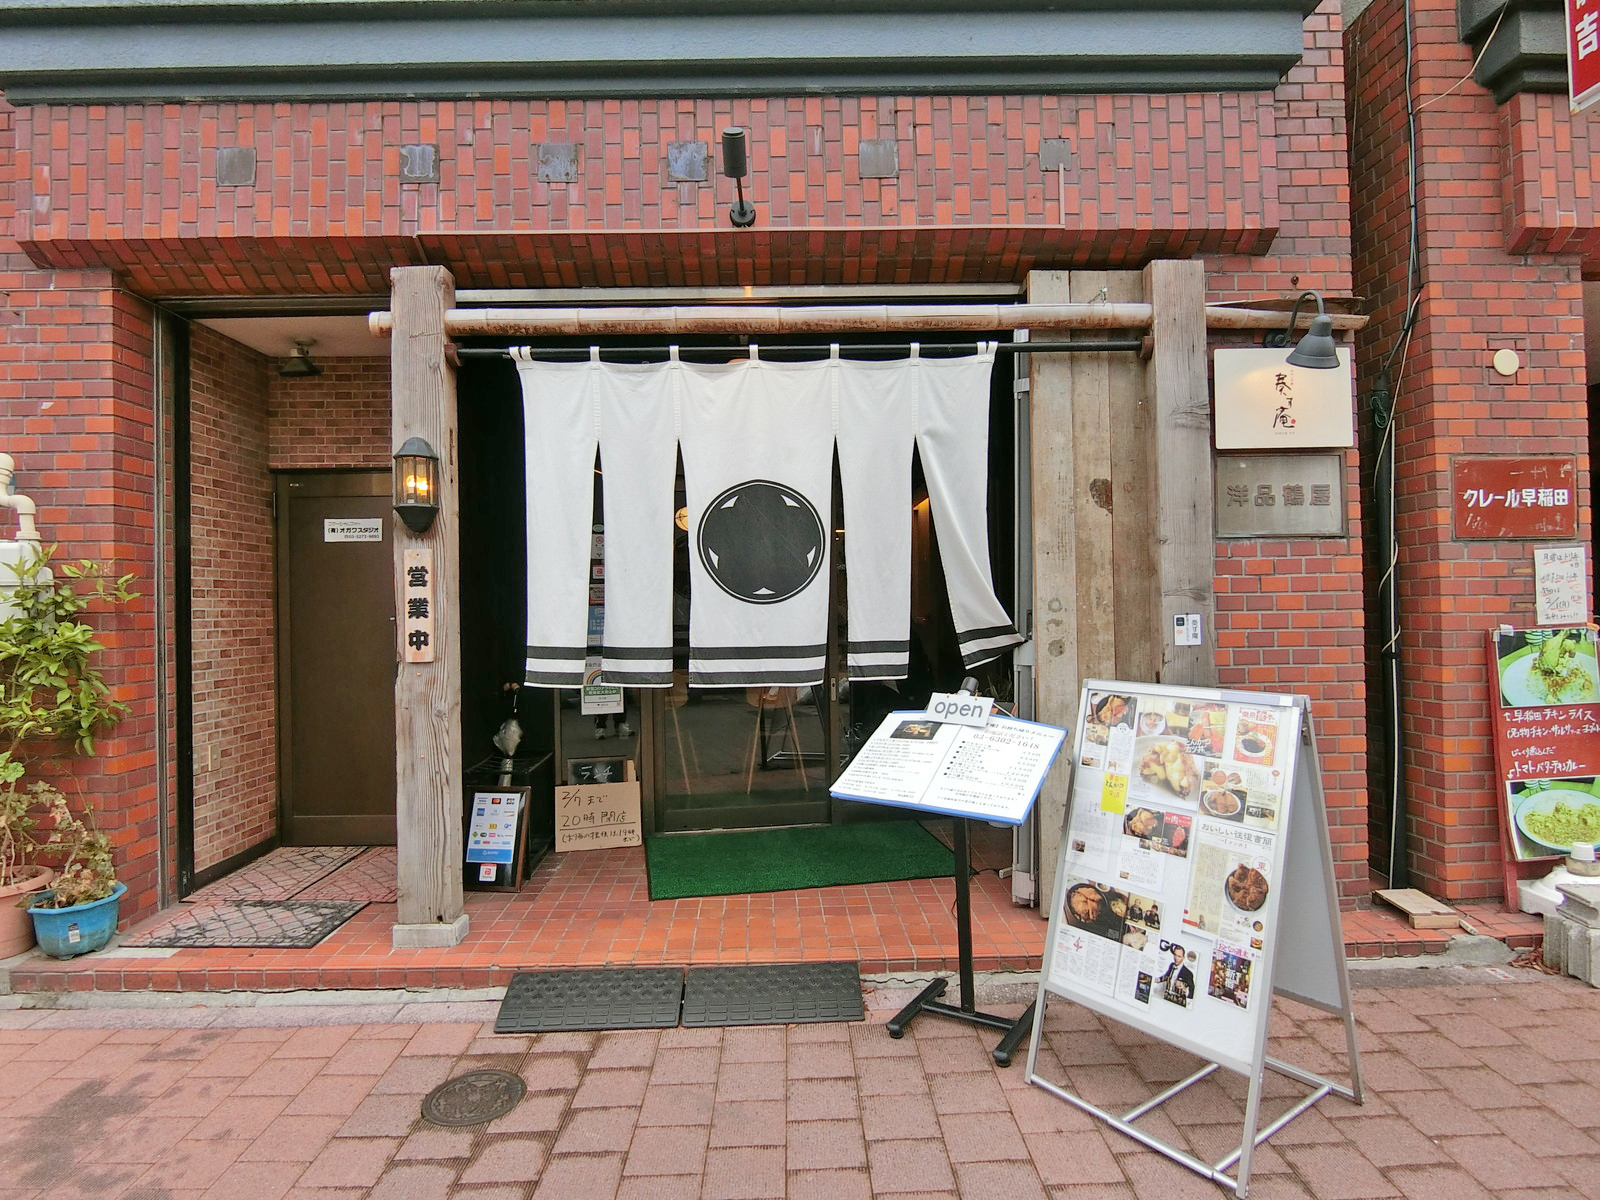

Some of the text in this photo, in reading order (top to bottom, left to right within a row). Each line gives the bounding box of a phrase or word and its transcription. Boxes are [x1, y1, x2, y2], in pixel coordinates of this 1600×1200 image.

[1575, 0, 1598, 60] 吉
[1226, 484, 1331, 507] 洋品鶴屋
[1463, 488, 1569, 508] クレール早稲田
[407, 566, 429, 651] 営業中
[934, 699, 983, 719] open
[580, 765, 613, 780] ランチ
[561, 789, 608, 808] 2/7 まで
[1201, 823, 1272, 847] おいしい往復書簡
